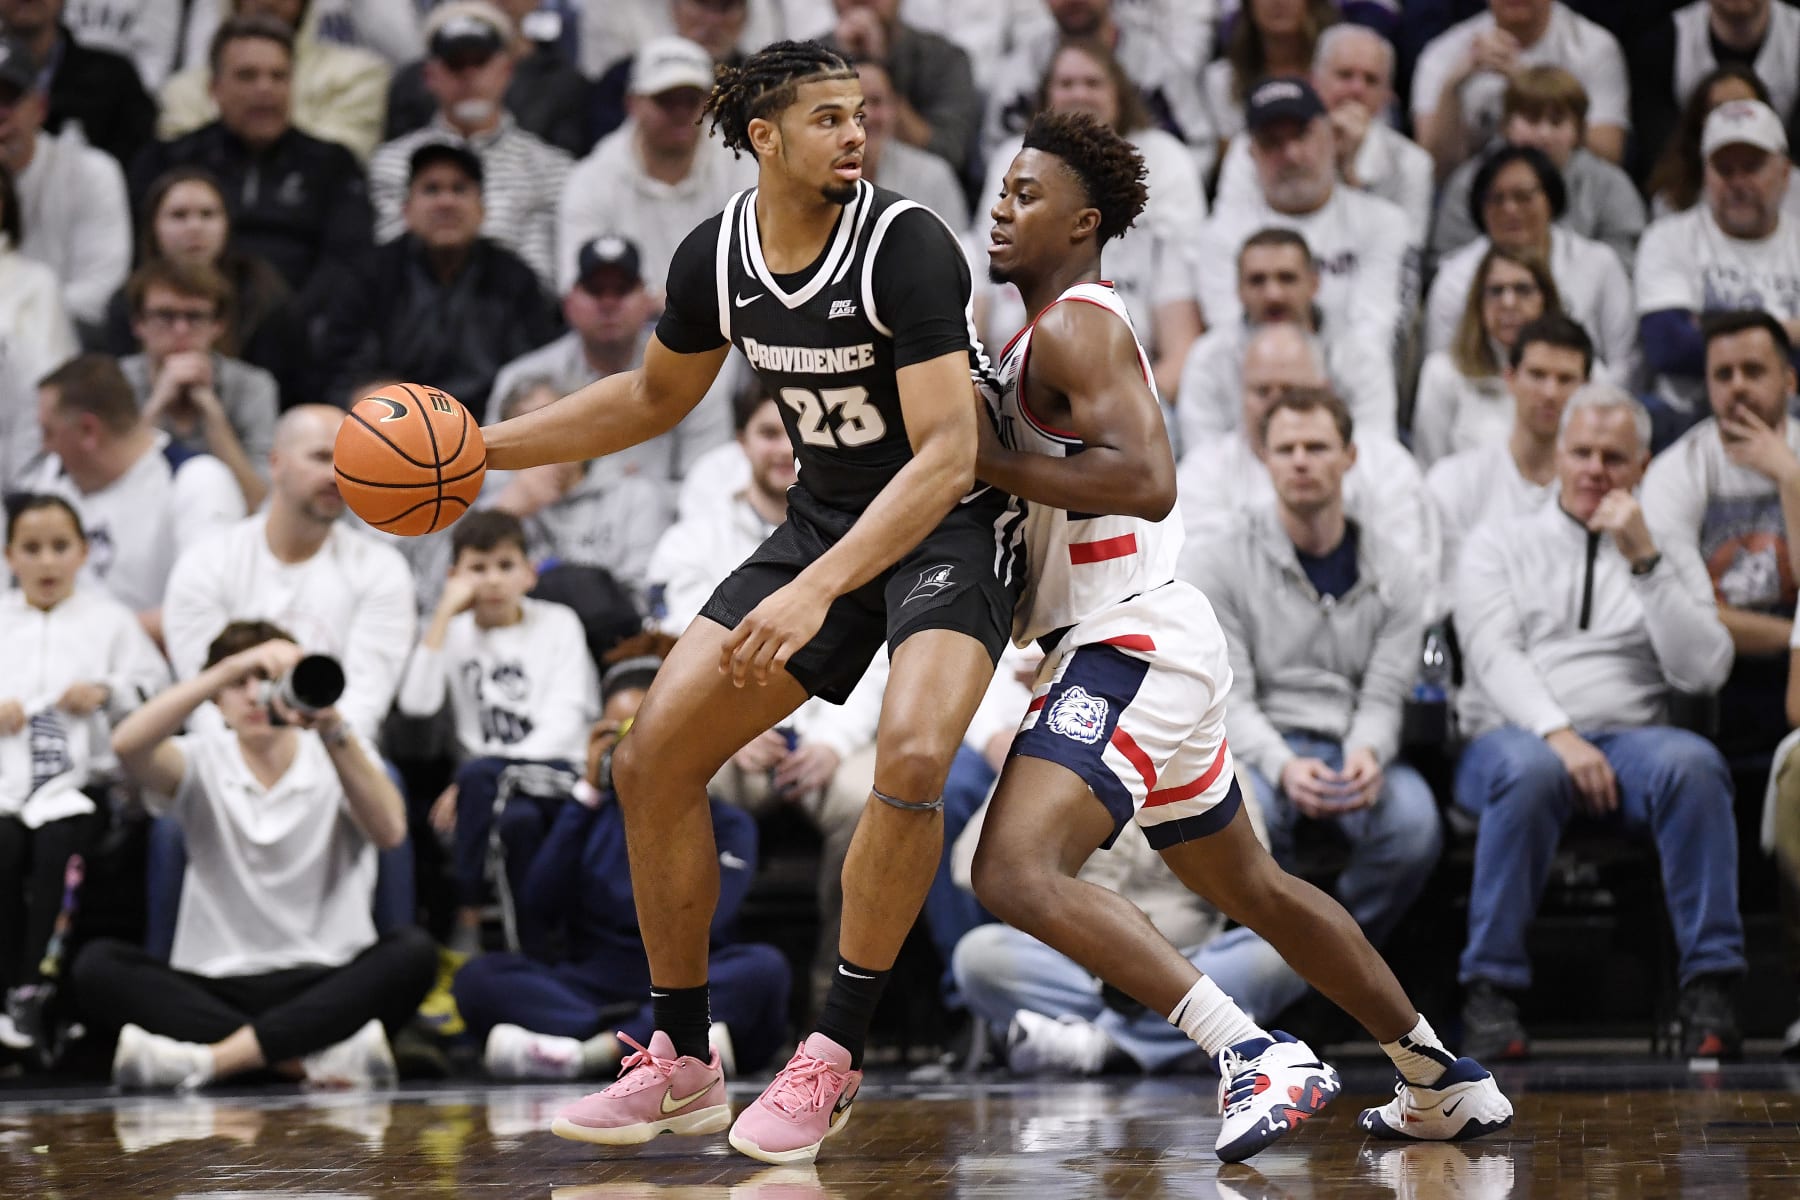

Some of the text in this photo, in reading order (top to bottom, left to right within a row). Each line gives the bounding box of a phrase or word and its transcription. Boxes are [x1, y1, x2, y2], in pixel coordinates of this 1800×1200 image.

[829, 306, 857, 315] EAST
[831, 300, 852, 308] BIG
[741, 336, 875, 373] PROVIDENCE
[780, 385, 886, 449] 23
